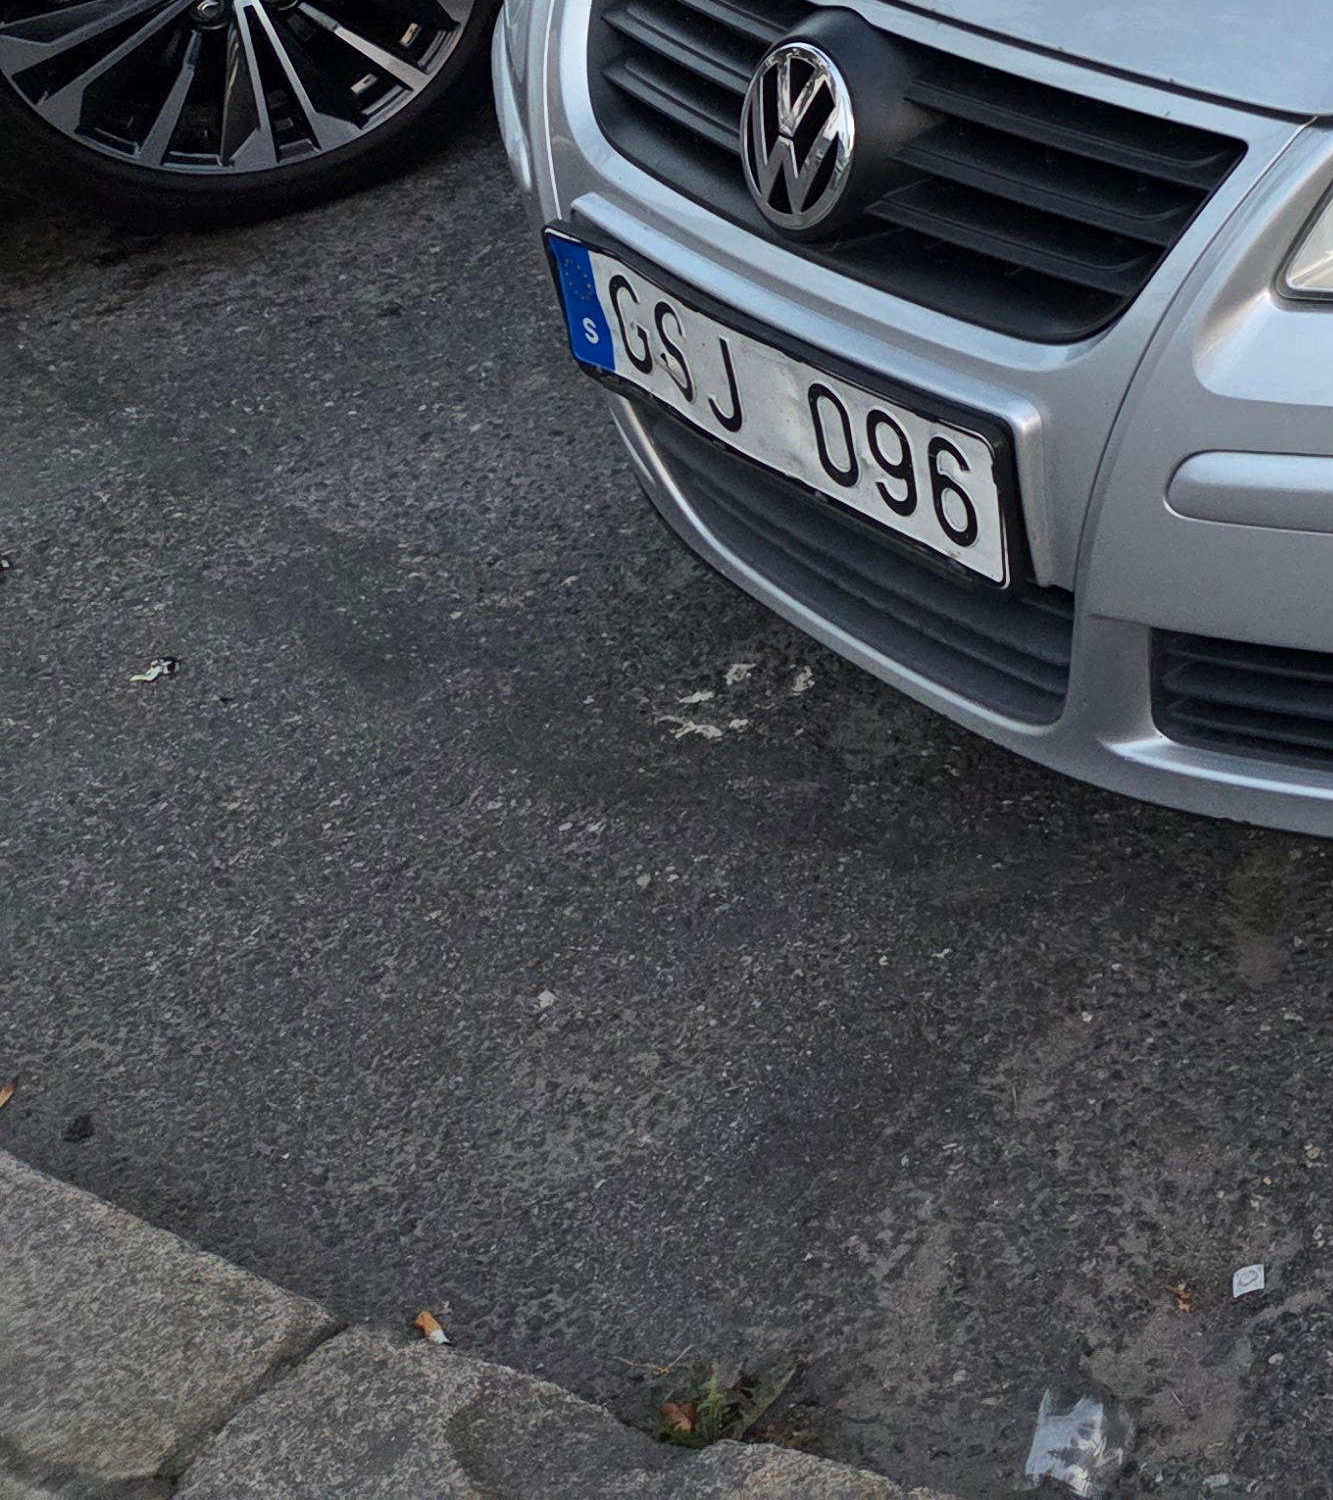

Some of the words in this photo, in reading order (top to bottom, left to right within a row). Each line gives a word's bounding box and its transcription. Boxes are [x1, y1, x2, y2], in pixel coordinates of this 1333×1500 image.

[581, 316, 600, 345] S
[608, 274, 744, 434] GSJ
[807, 382, 980, 548] 096
